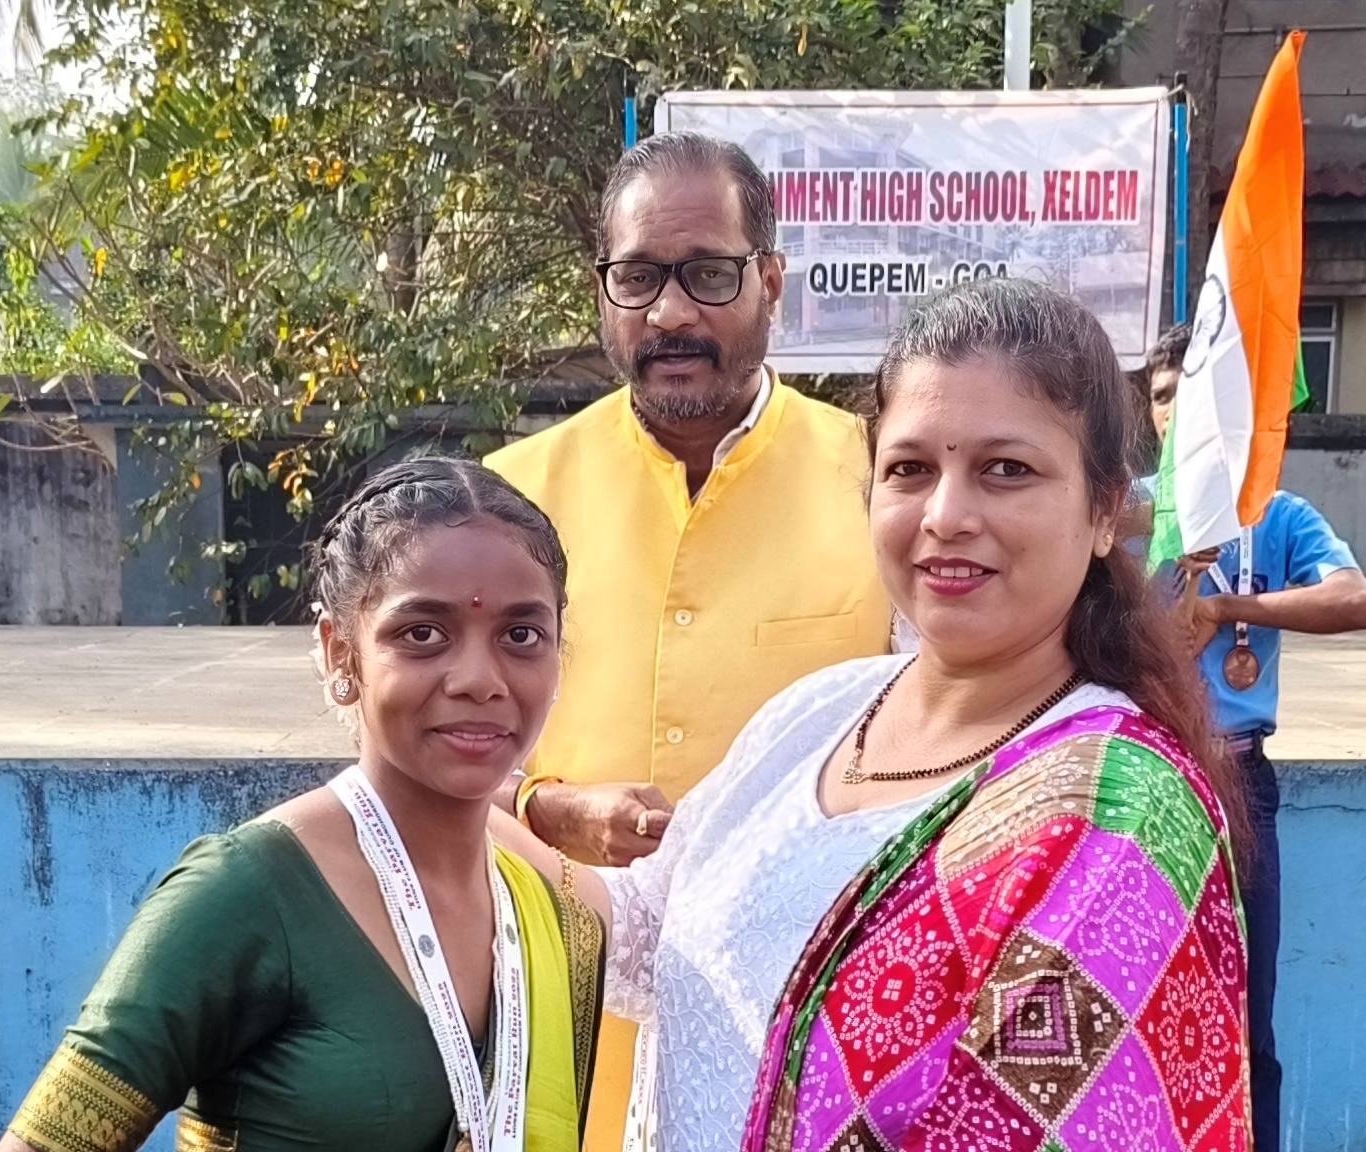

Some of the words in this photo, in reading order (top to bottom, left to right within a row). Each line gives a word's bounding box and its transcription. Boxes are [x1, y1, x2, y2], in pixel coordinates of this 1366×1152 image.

[769, 171, 855, 222] NMENT
[860, 171, 923, 222] HIGH
[929, 171, 1036, 226] SCHOOL,
[1042, 170, 1138, 222] XELDEM
[809, 262, 926, 293] QUEPEM
[507, 1044, 518, 1098] Parvat
[504, 1105, 512, 1136] The
